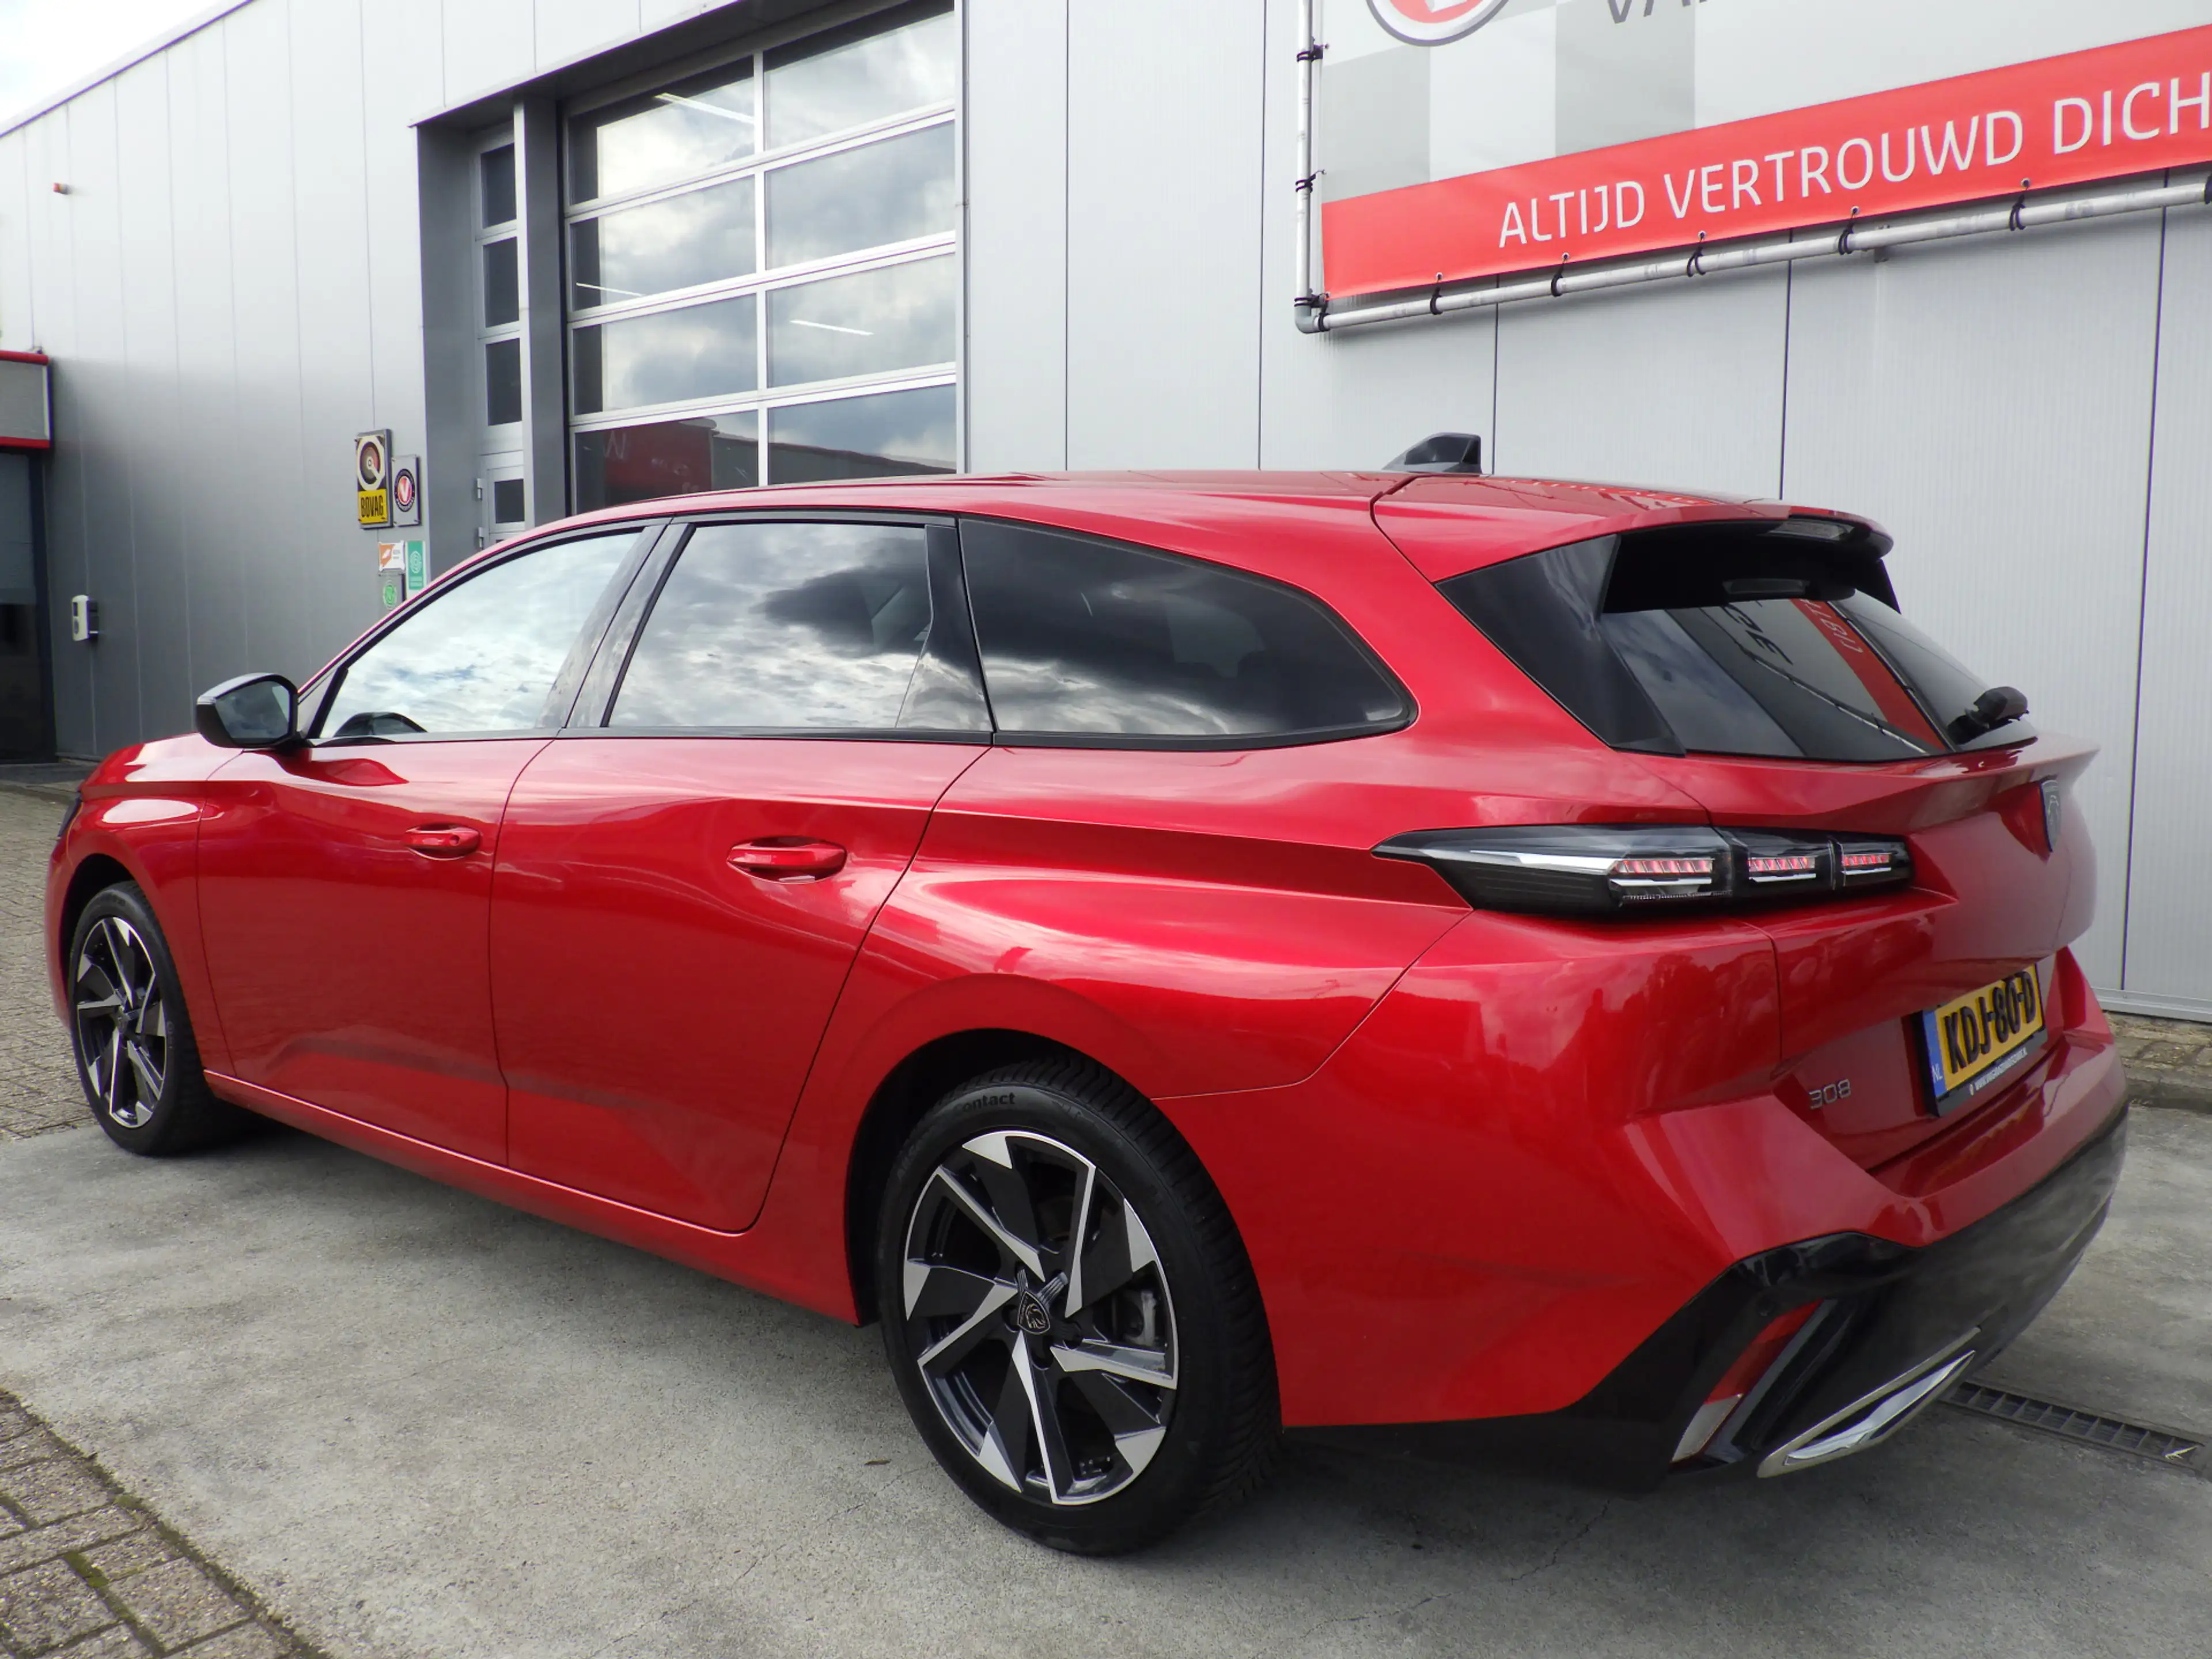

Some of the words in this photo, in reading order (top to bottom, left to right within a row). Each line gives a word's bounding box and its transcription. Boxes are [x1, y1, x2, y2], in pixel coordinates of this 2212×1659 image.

[1499, 181, 1645, 248] ALTIJD
[1663, 111, 2024, 219] VERTROUWD
[2054, 71, 2211, 155] DICH
[360, 495, 384, 518] BOVAG
[1943, 971, 2036, 1074] KDJ-80-D
[1930, 1063, 1943, 1084] NL
[1808, 1079, 1851, 1109] 308
